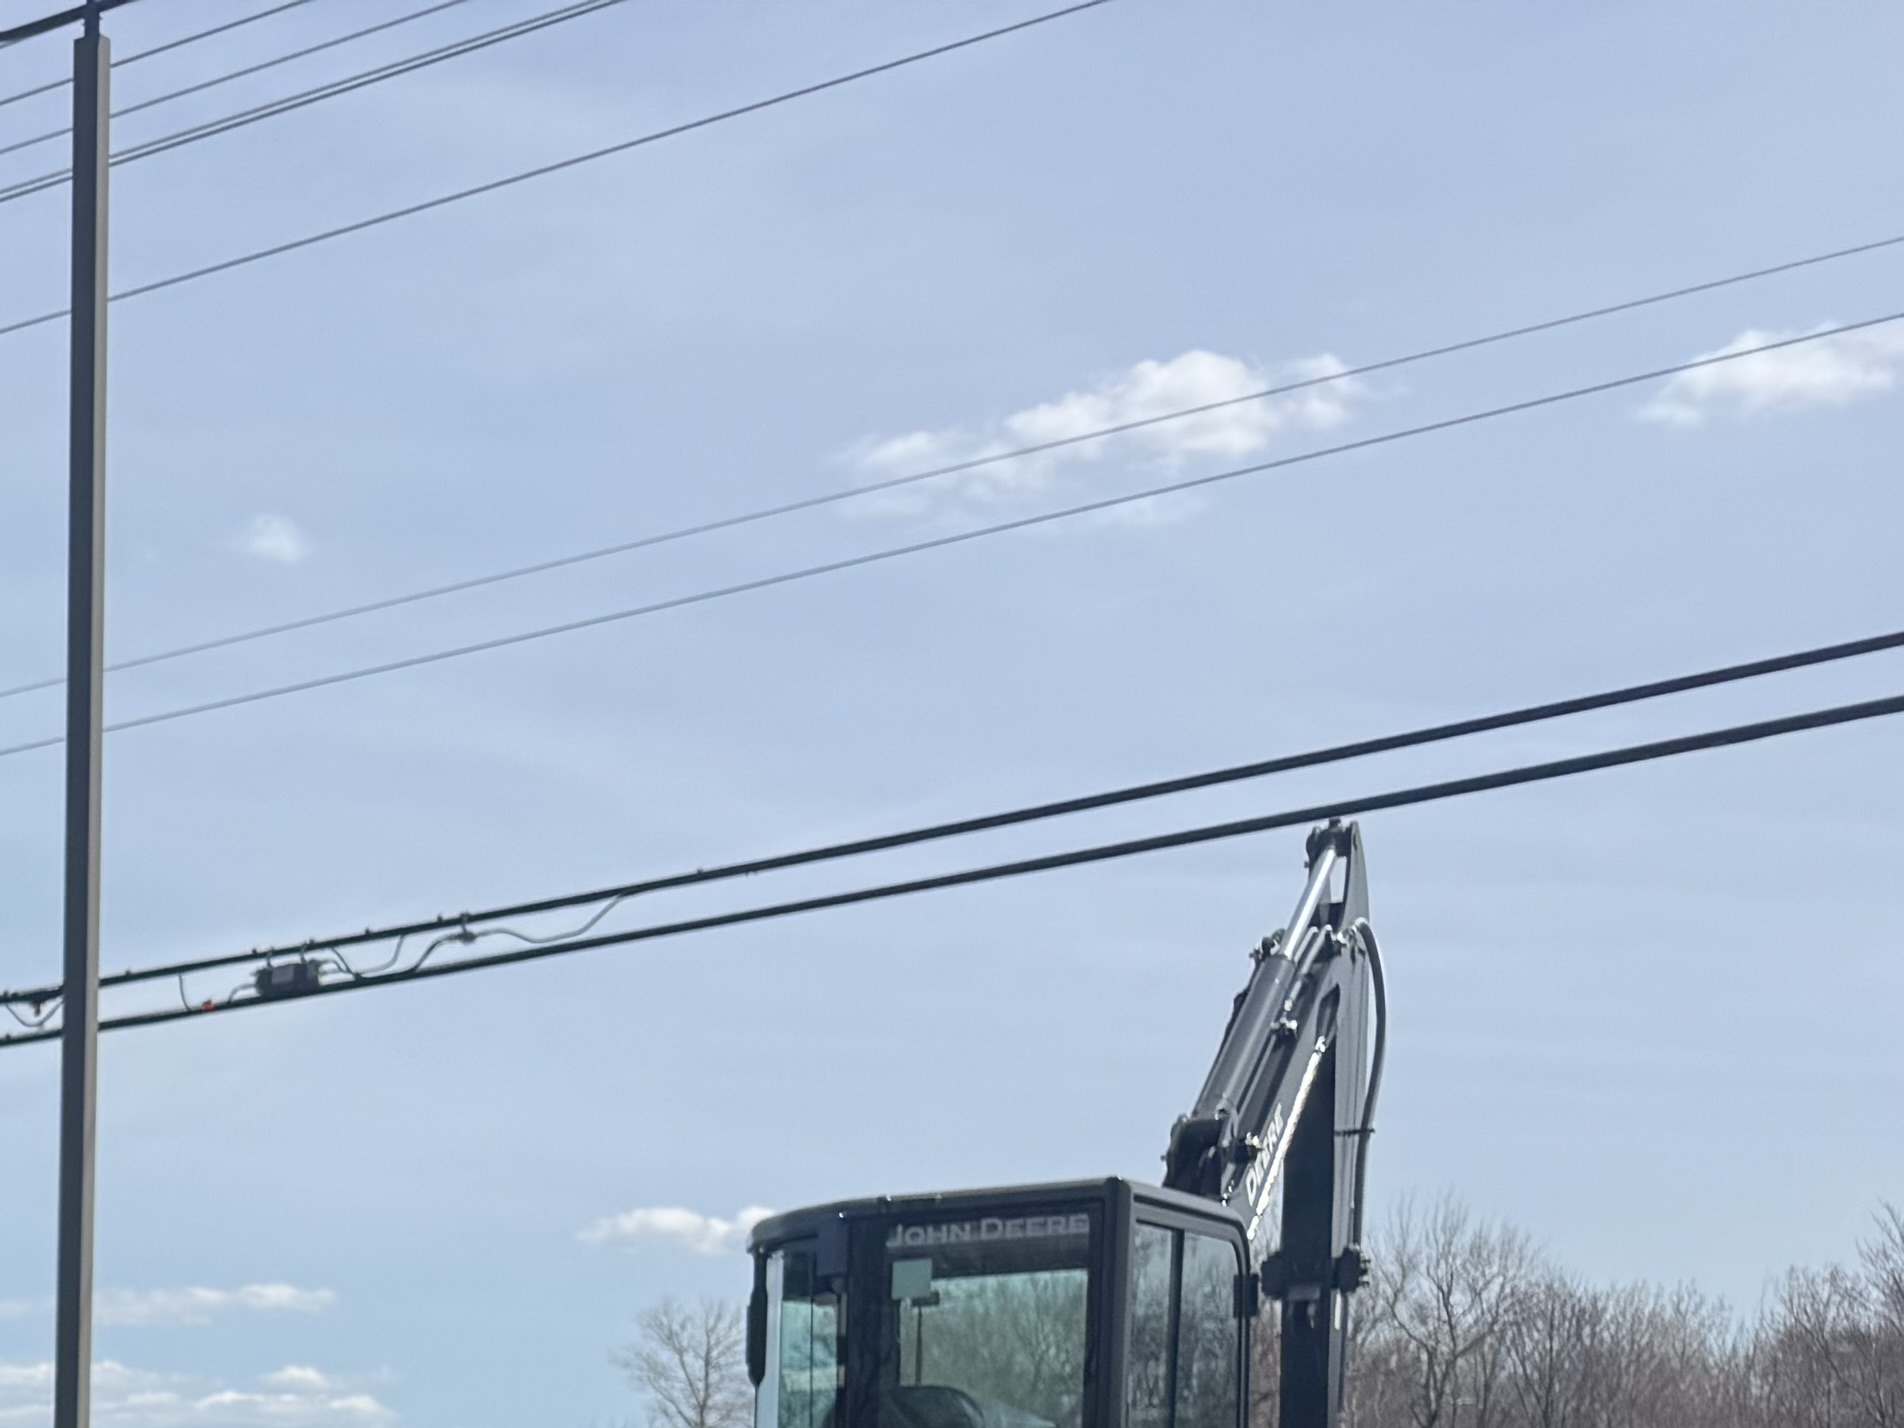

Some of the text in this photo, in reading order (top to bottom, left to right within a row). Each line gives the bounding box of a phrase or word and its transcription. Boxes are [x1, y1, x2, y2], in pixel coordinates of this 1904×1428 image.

[1246, 1103, 1283, 1207] DEERE
[885, 1213, 1090, 1247] JOHN DEERE
